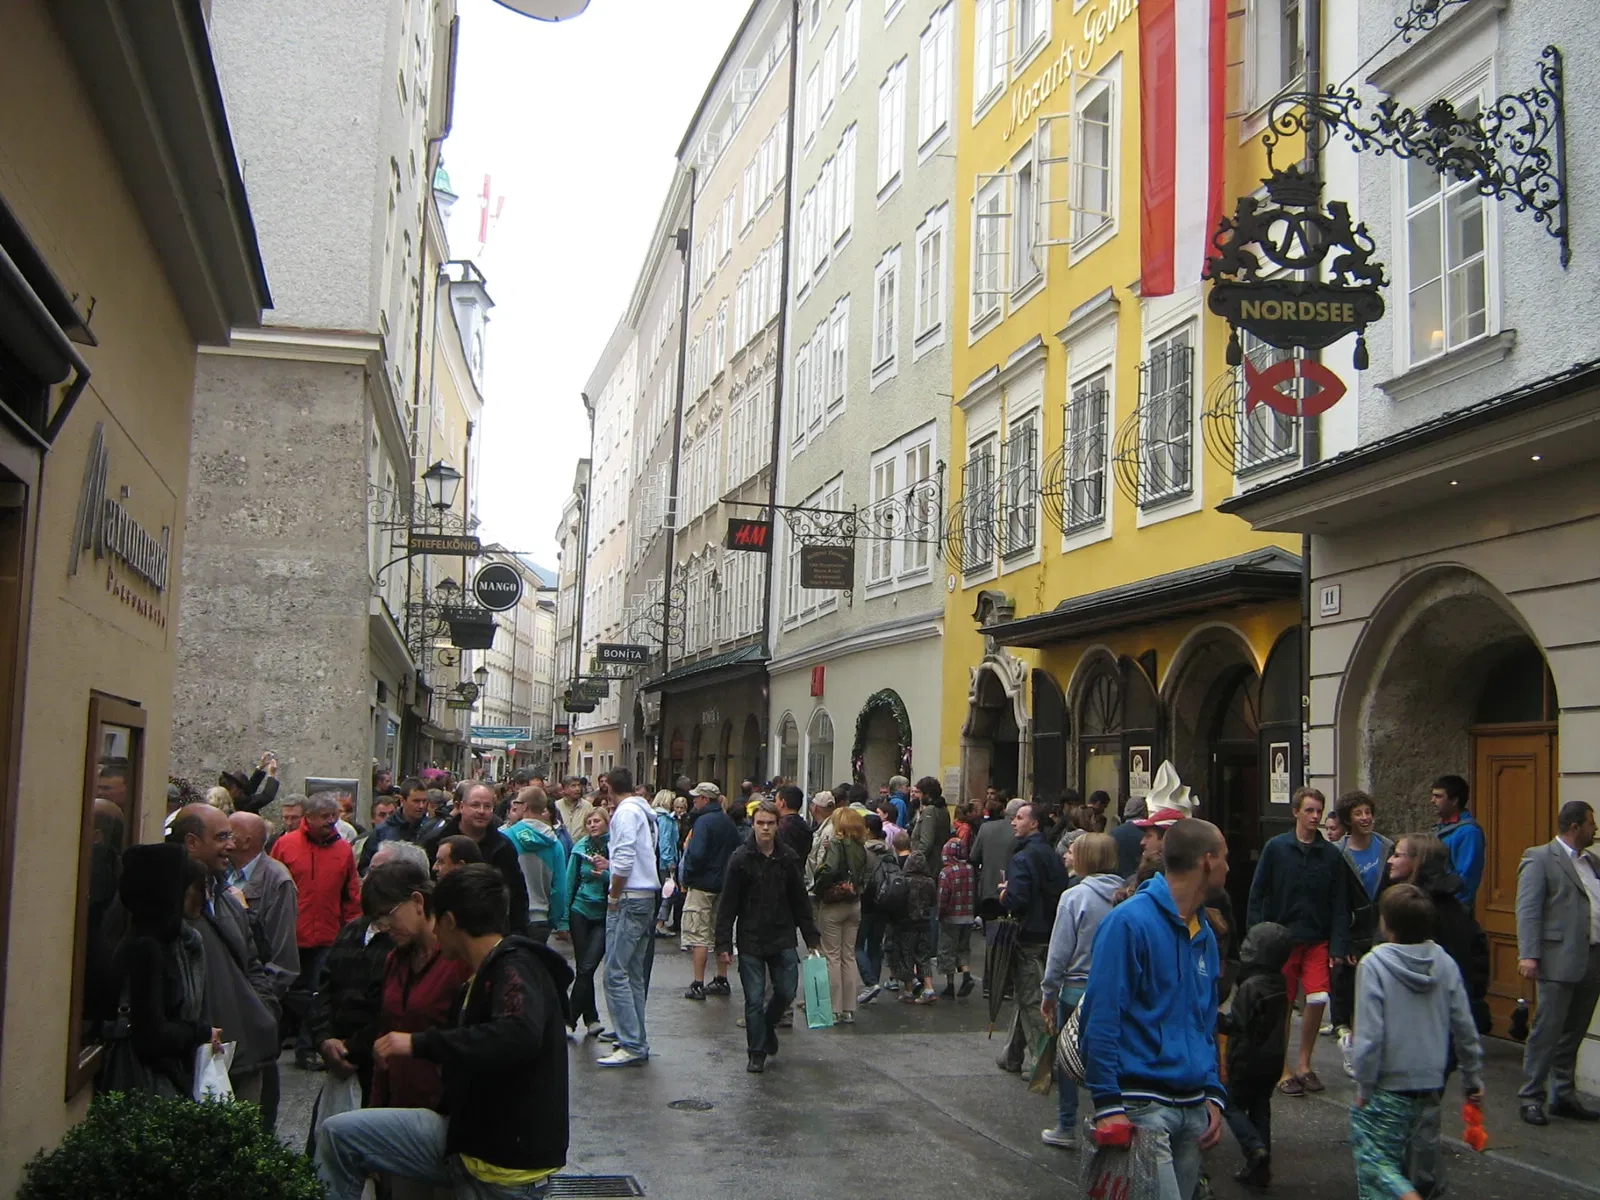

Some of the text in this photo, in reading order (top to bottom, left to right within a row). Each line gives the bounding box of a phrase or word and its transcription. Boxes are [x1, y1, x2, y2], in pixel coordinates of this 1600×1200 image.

[1003, 0, 1139, 141] Mozarts Gebu
[1241, 299, 1355, 323] NORDSEE
[411, 538, 478, 551] STIEFELKÖNIG
[735, 524, 767, 547] H&M
[479, 581, 517, 592] MANGO
[1325, 590, 1334, 605] 11
